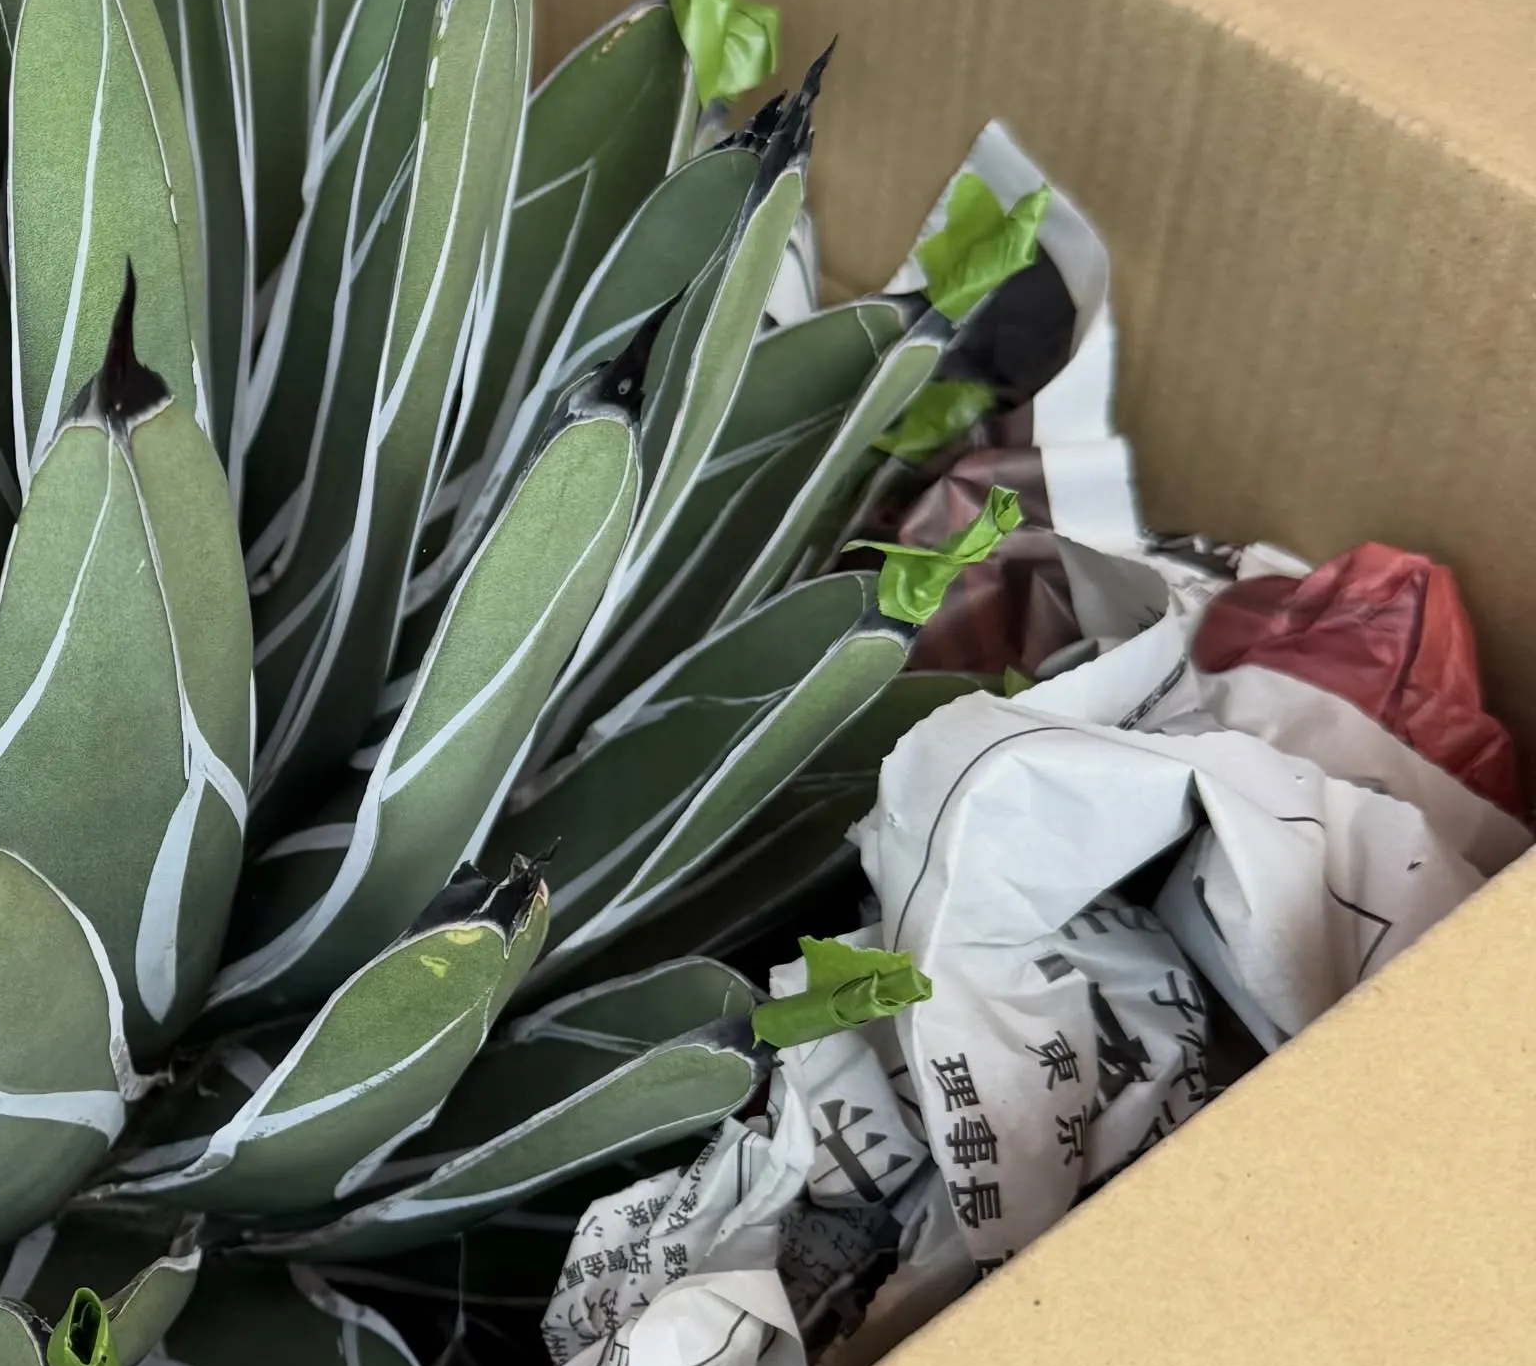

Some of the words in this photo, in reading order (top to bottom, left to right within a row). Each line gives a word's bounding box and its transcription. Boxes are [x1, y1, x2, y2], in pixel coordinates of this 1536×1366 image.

[931, 1052, 1002, 1229] 理事長
[1025, 1031, 1089, 1166] 東京
